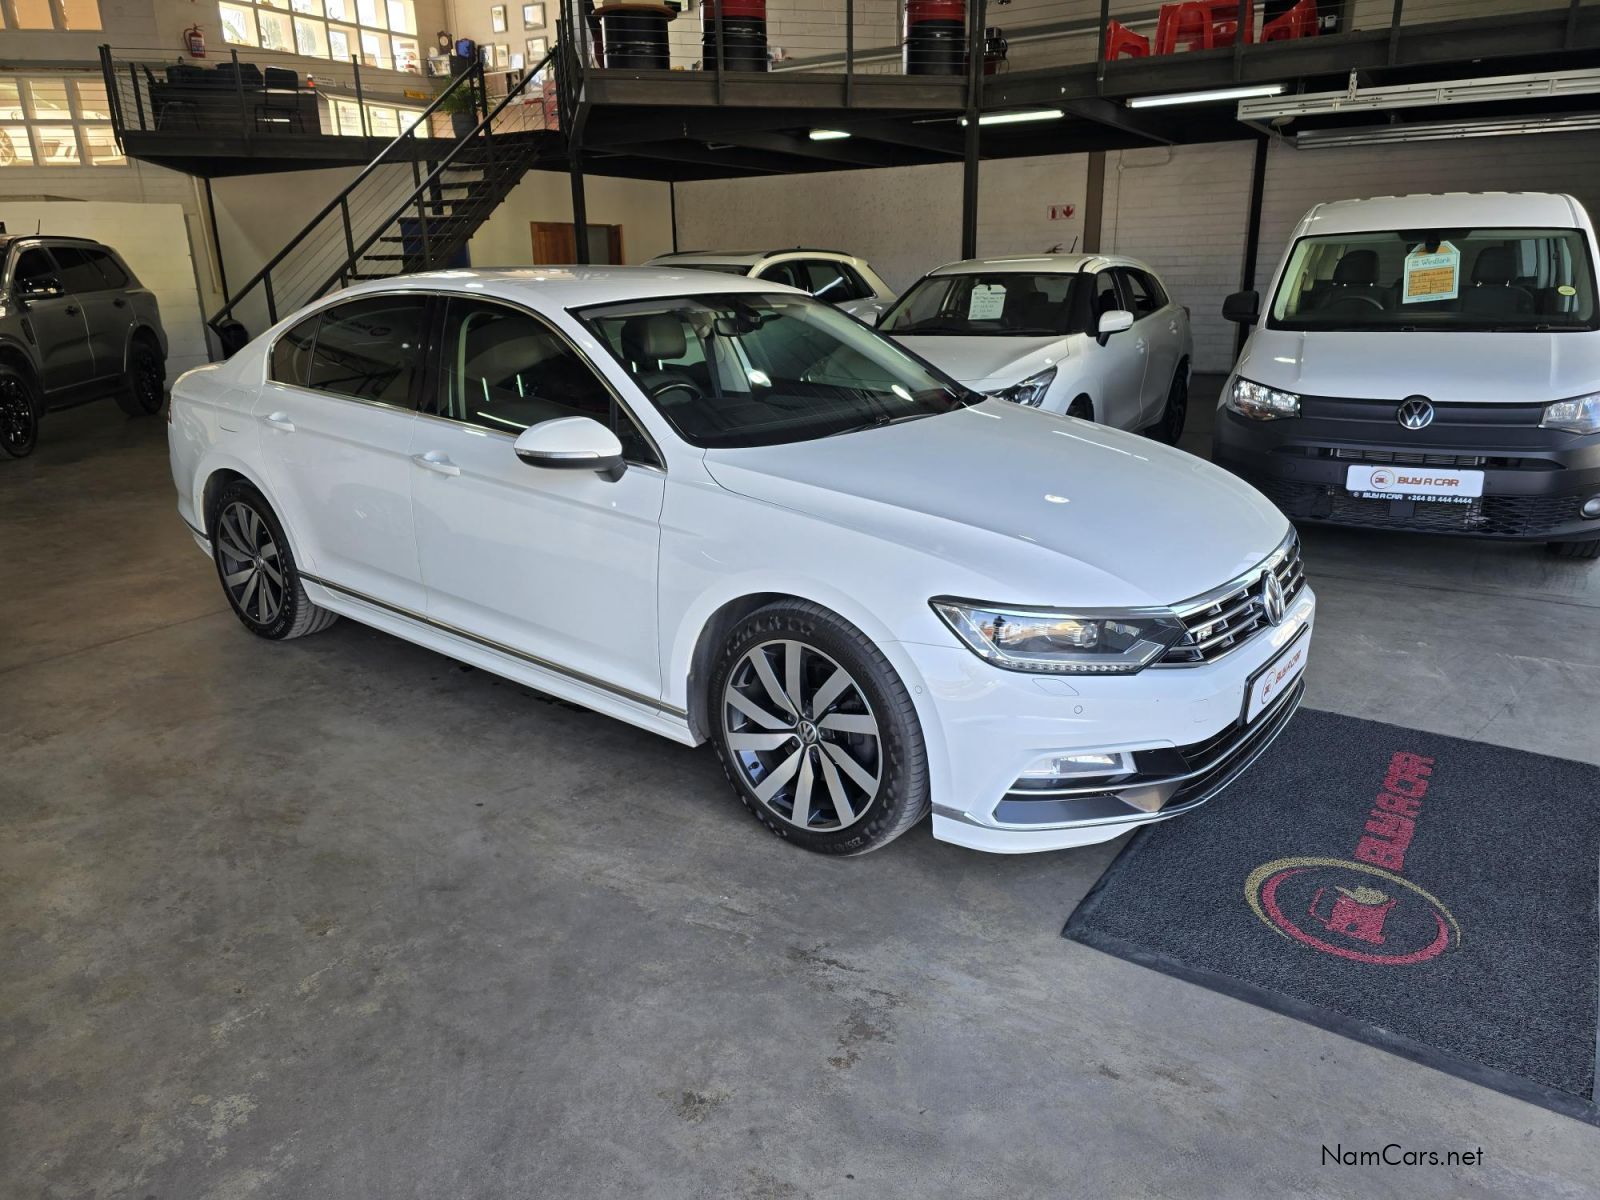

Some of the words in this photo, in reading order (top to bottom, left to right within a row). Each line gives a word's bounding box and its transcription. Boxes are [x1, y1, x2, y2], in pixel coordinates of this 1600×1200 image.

[1397, 476, 1421, 485] BUY
[1423, 478, 1432, 486] A
[1434, 478, 1459, 487] CAR
